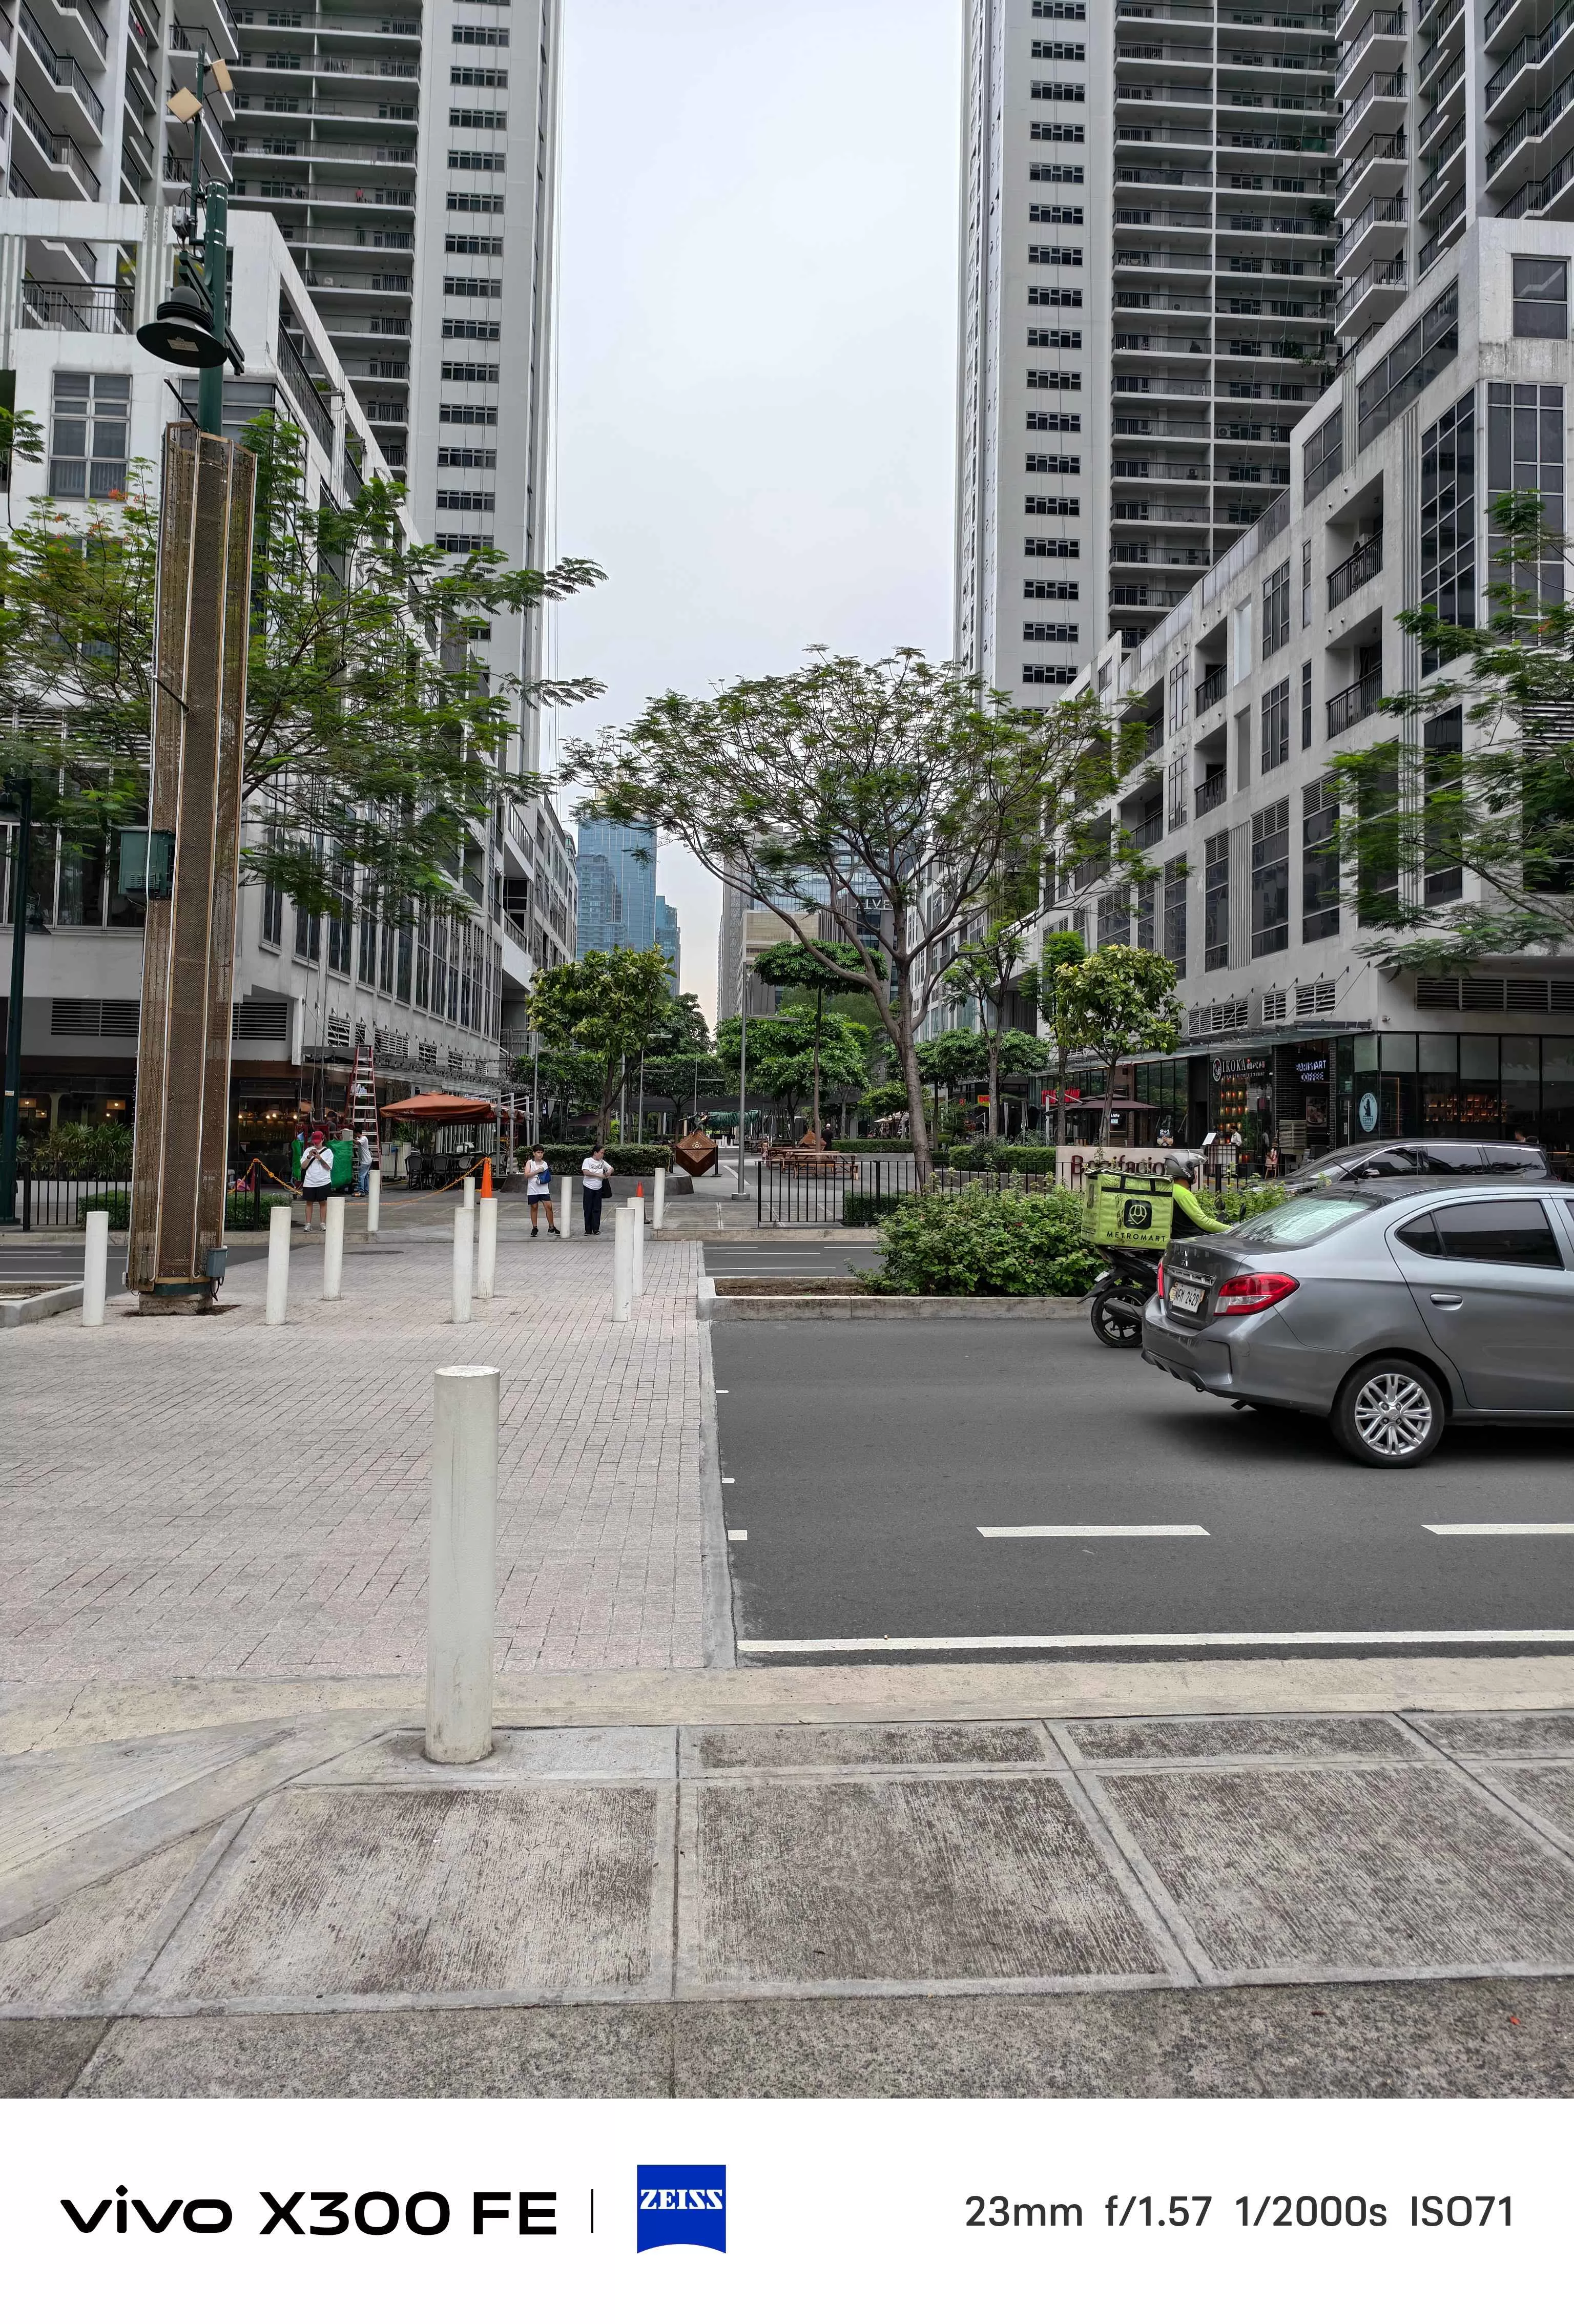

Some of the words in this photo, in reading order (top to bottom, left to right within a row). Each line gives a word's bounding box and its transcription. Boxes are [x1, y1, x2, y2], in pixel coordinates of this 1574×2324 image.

[1222, 1058, 1246, 1072] IKOKA
[1106, 1231, 1166, 1242] METROMART
[1185, 1291, 1199, 1307] 2429
